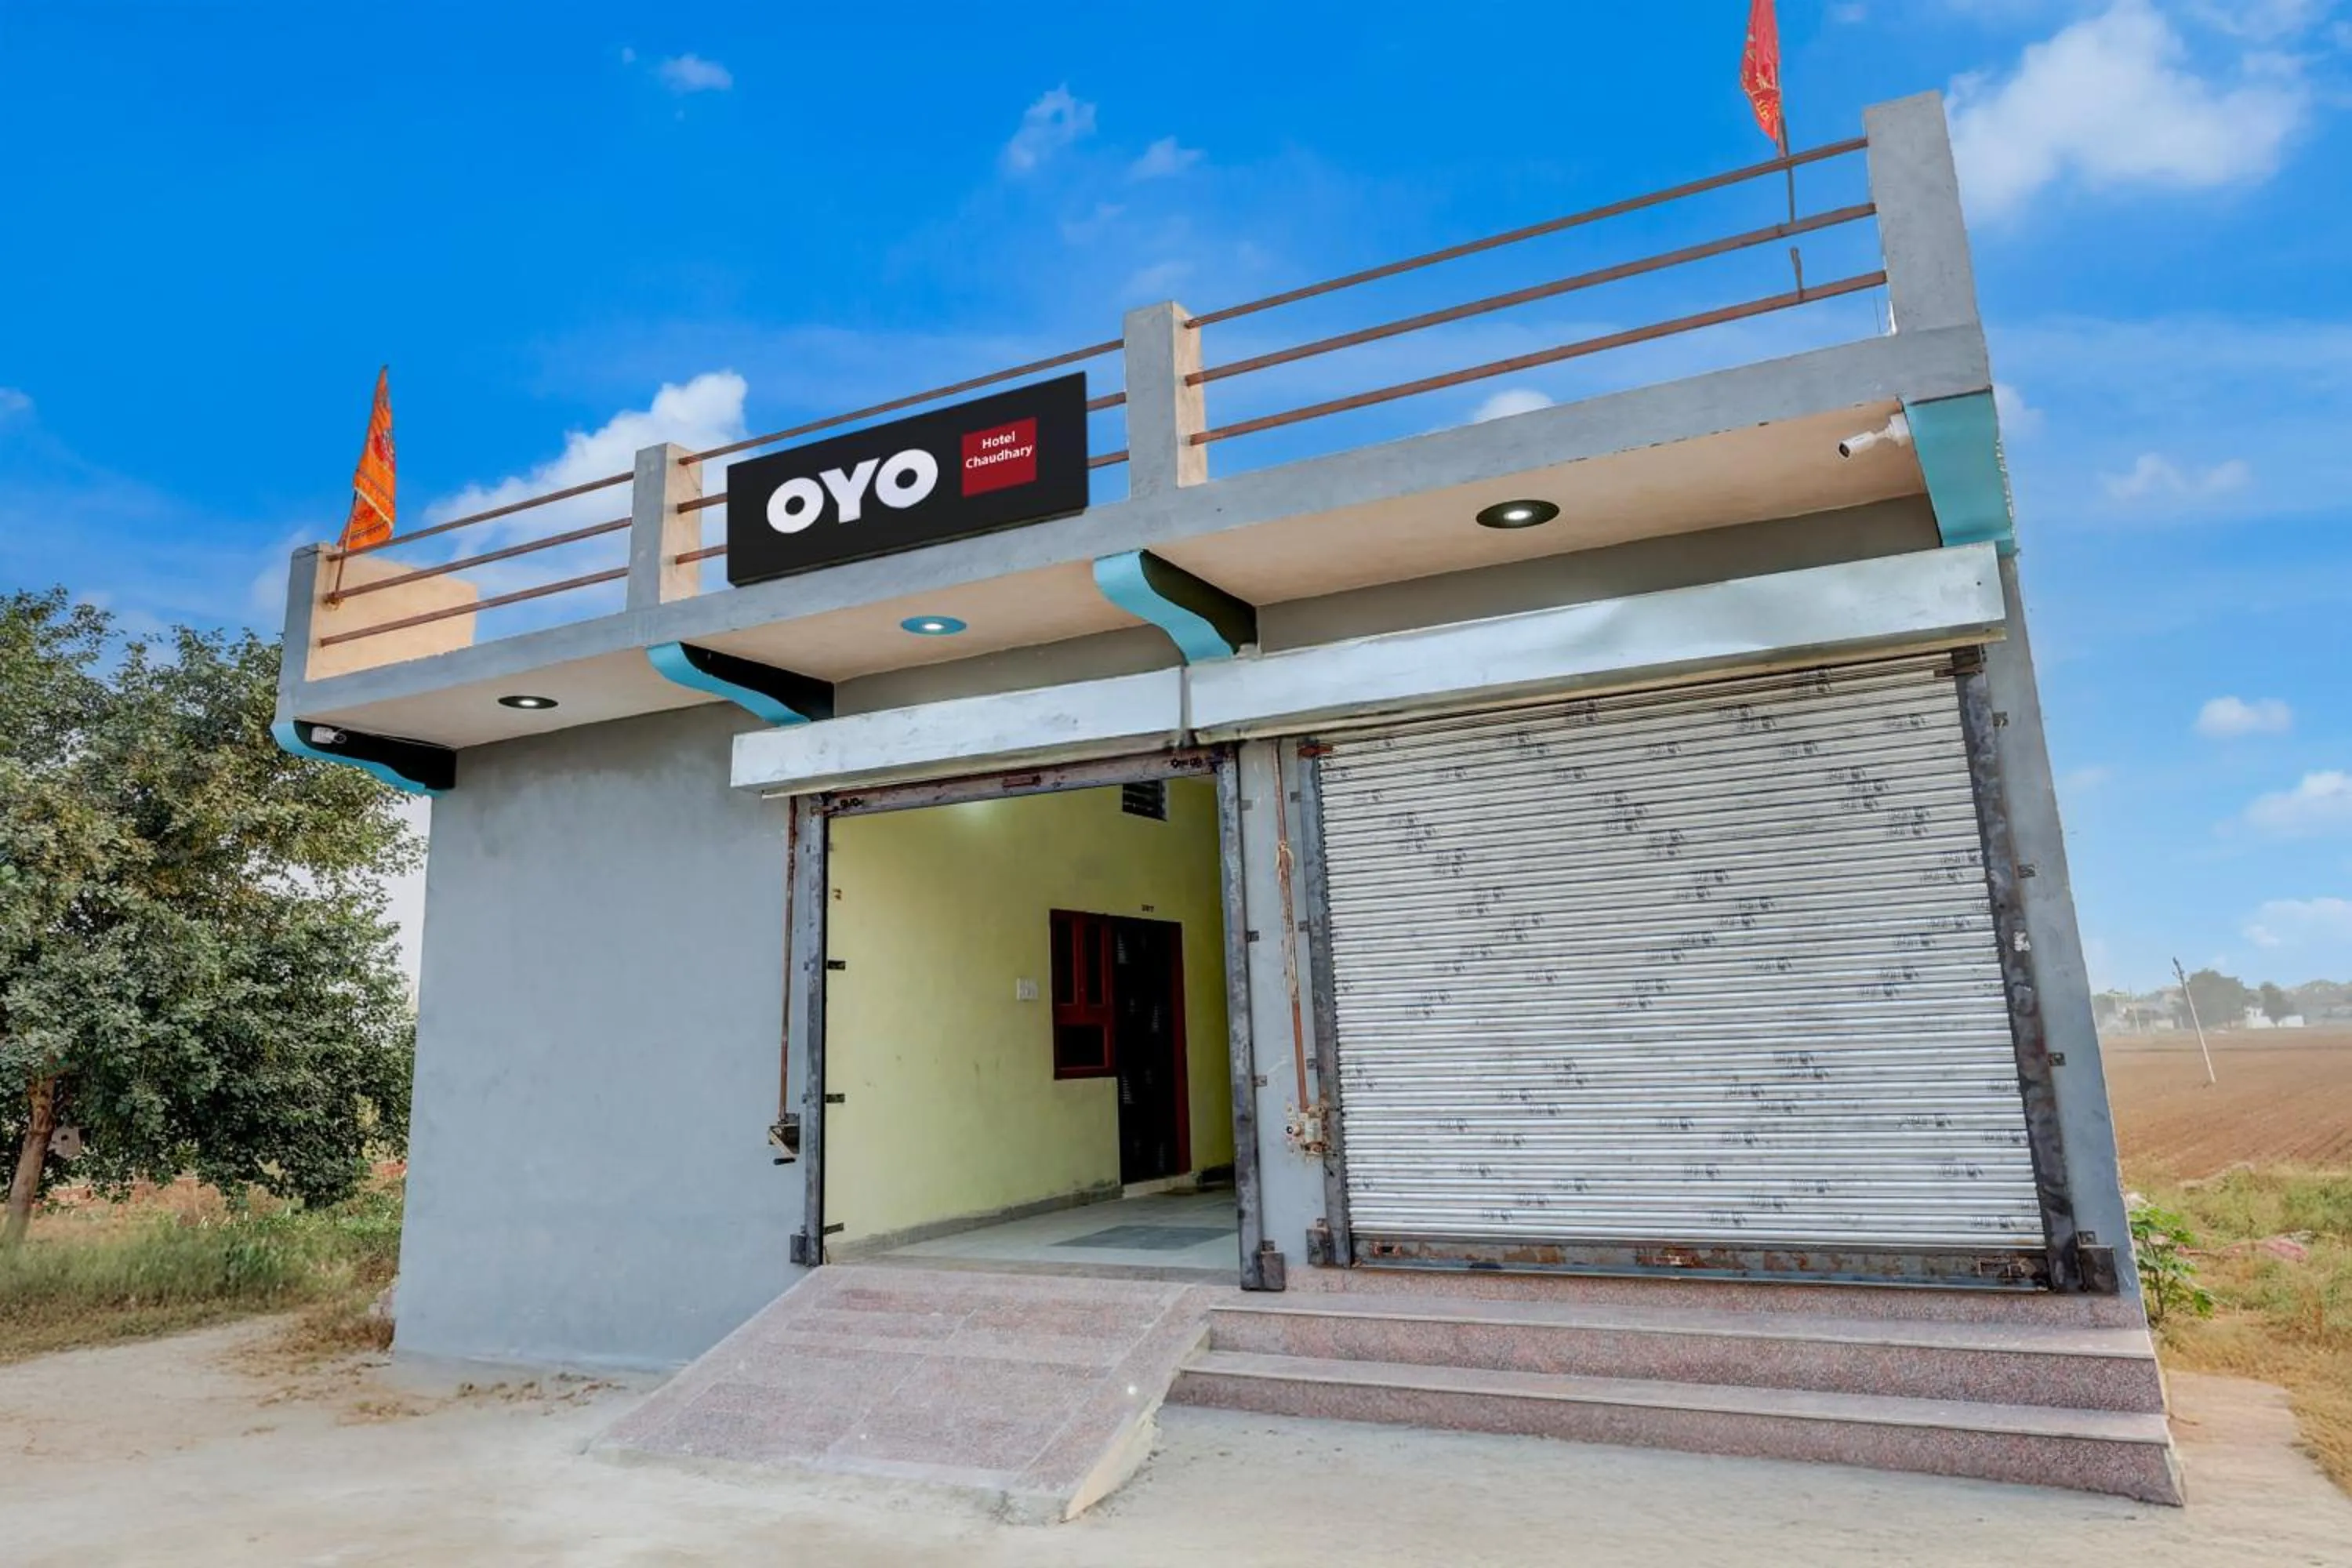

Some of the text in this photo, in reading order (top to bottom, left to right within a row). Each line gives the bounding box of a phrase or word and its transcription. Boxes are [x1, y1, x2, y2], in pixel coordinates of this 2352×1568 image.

[982, 430, 1015, 449] Hotel
[965, 445, 1033, 469] Chaudhary
[766, 448, 938, 534] OYO
